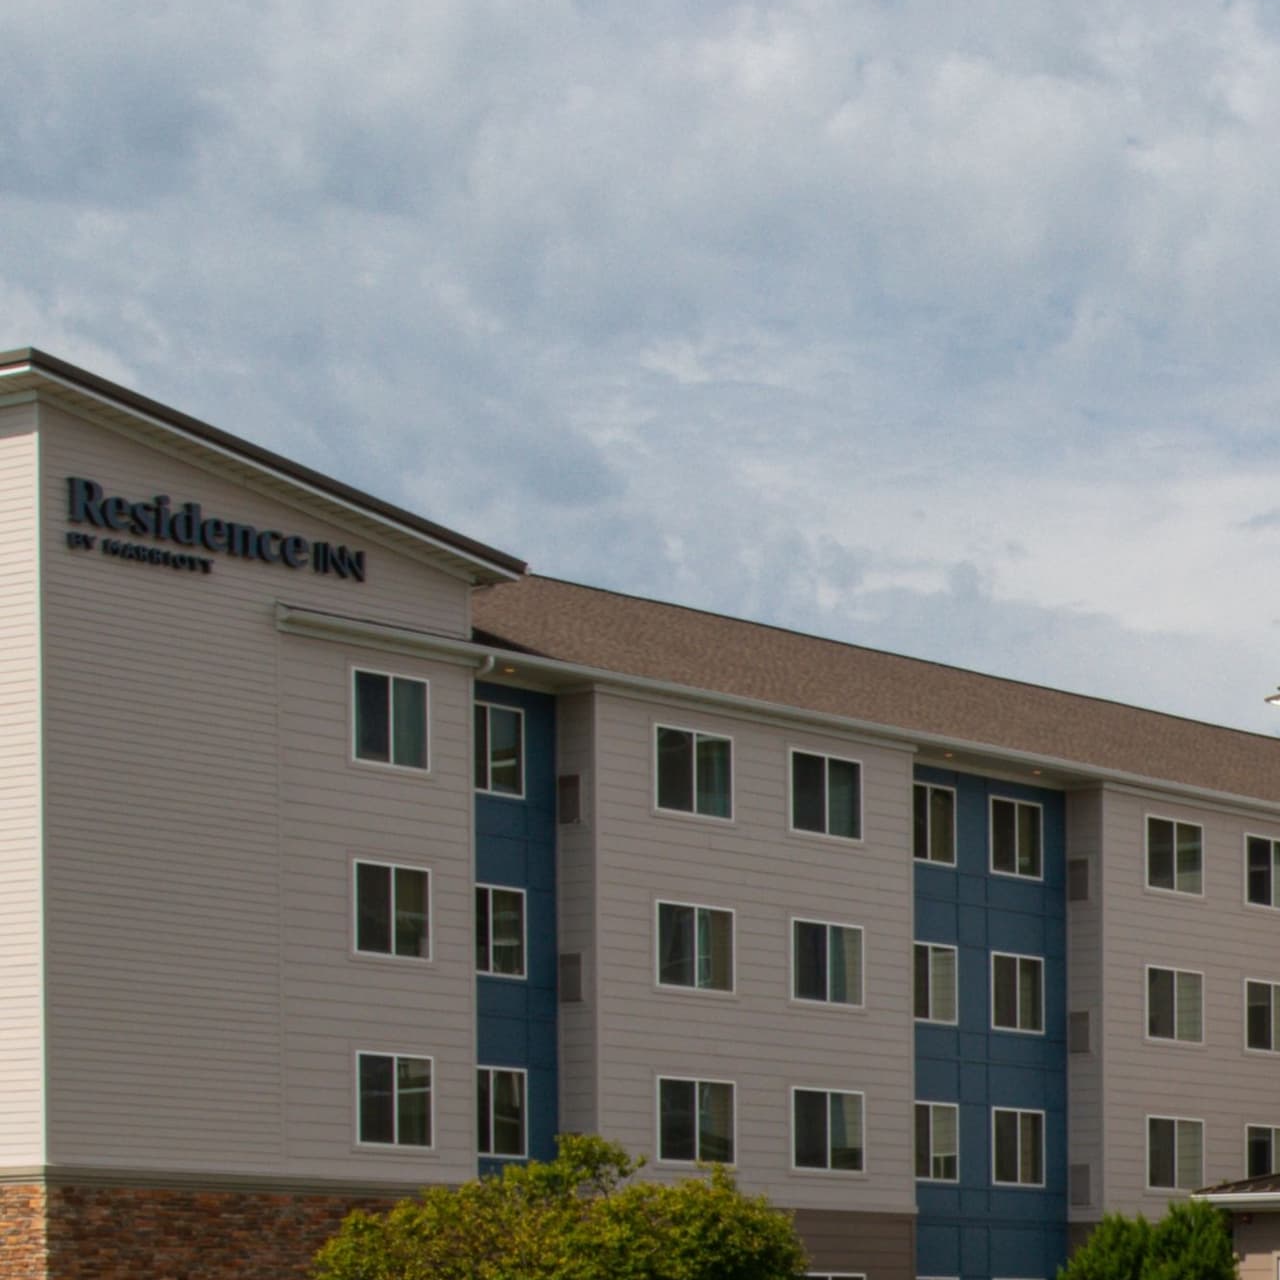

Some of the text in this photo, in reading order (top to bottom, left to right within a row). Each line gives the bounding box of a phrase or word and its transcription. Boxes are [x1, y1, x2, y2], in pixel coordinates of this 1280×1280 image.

[66, 477, 366, 582] Residence INN
[66, 531, 214, 575] BY MARRIOTT
